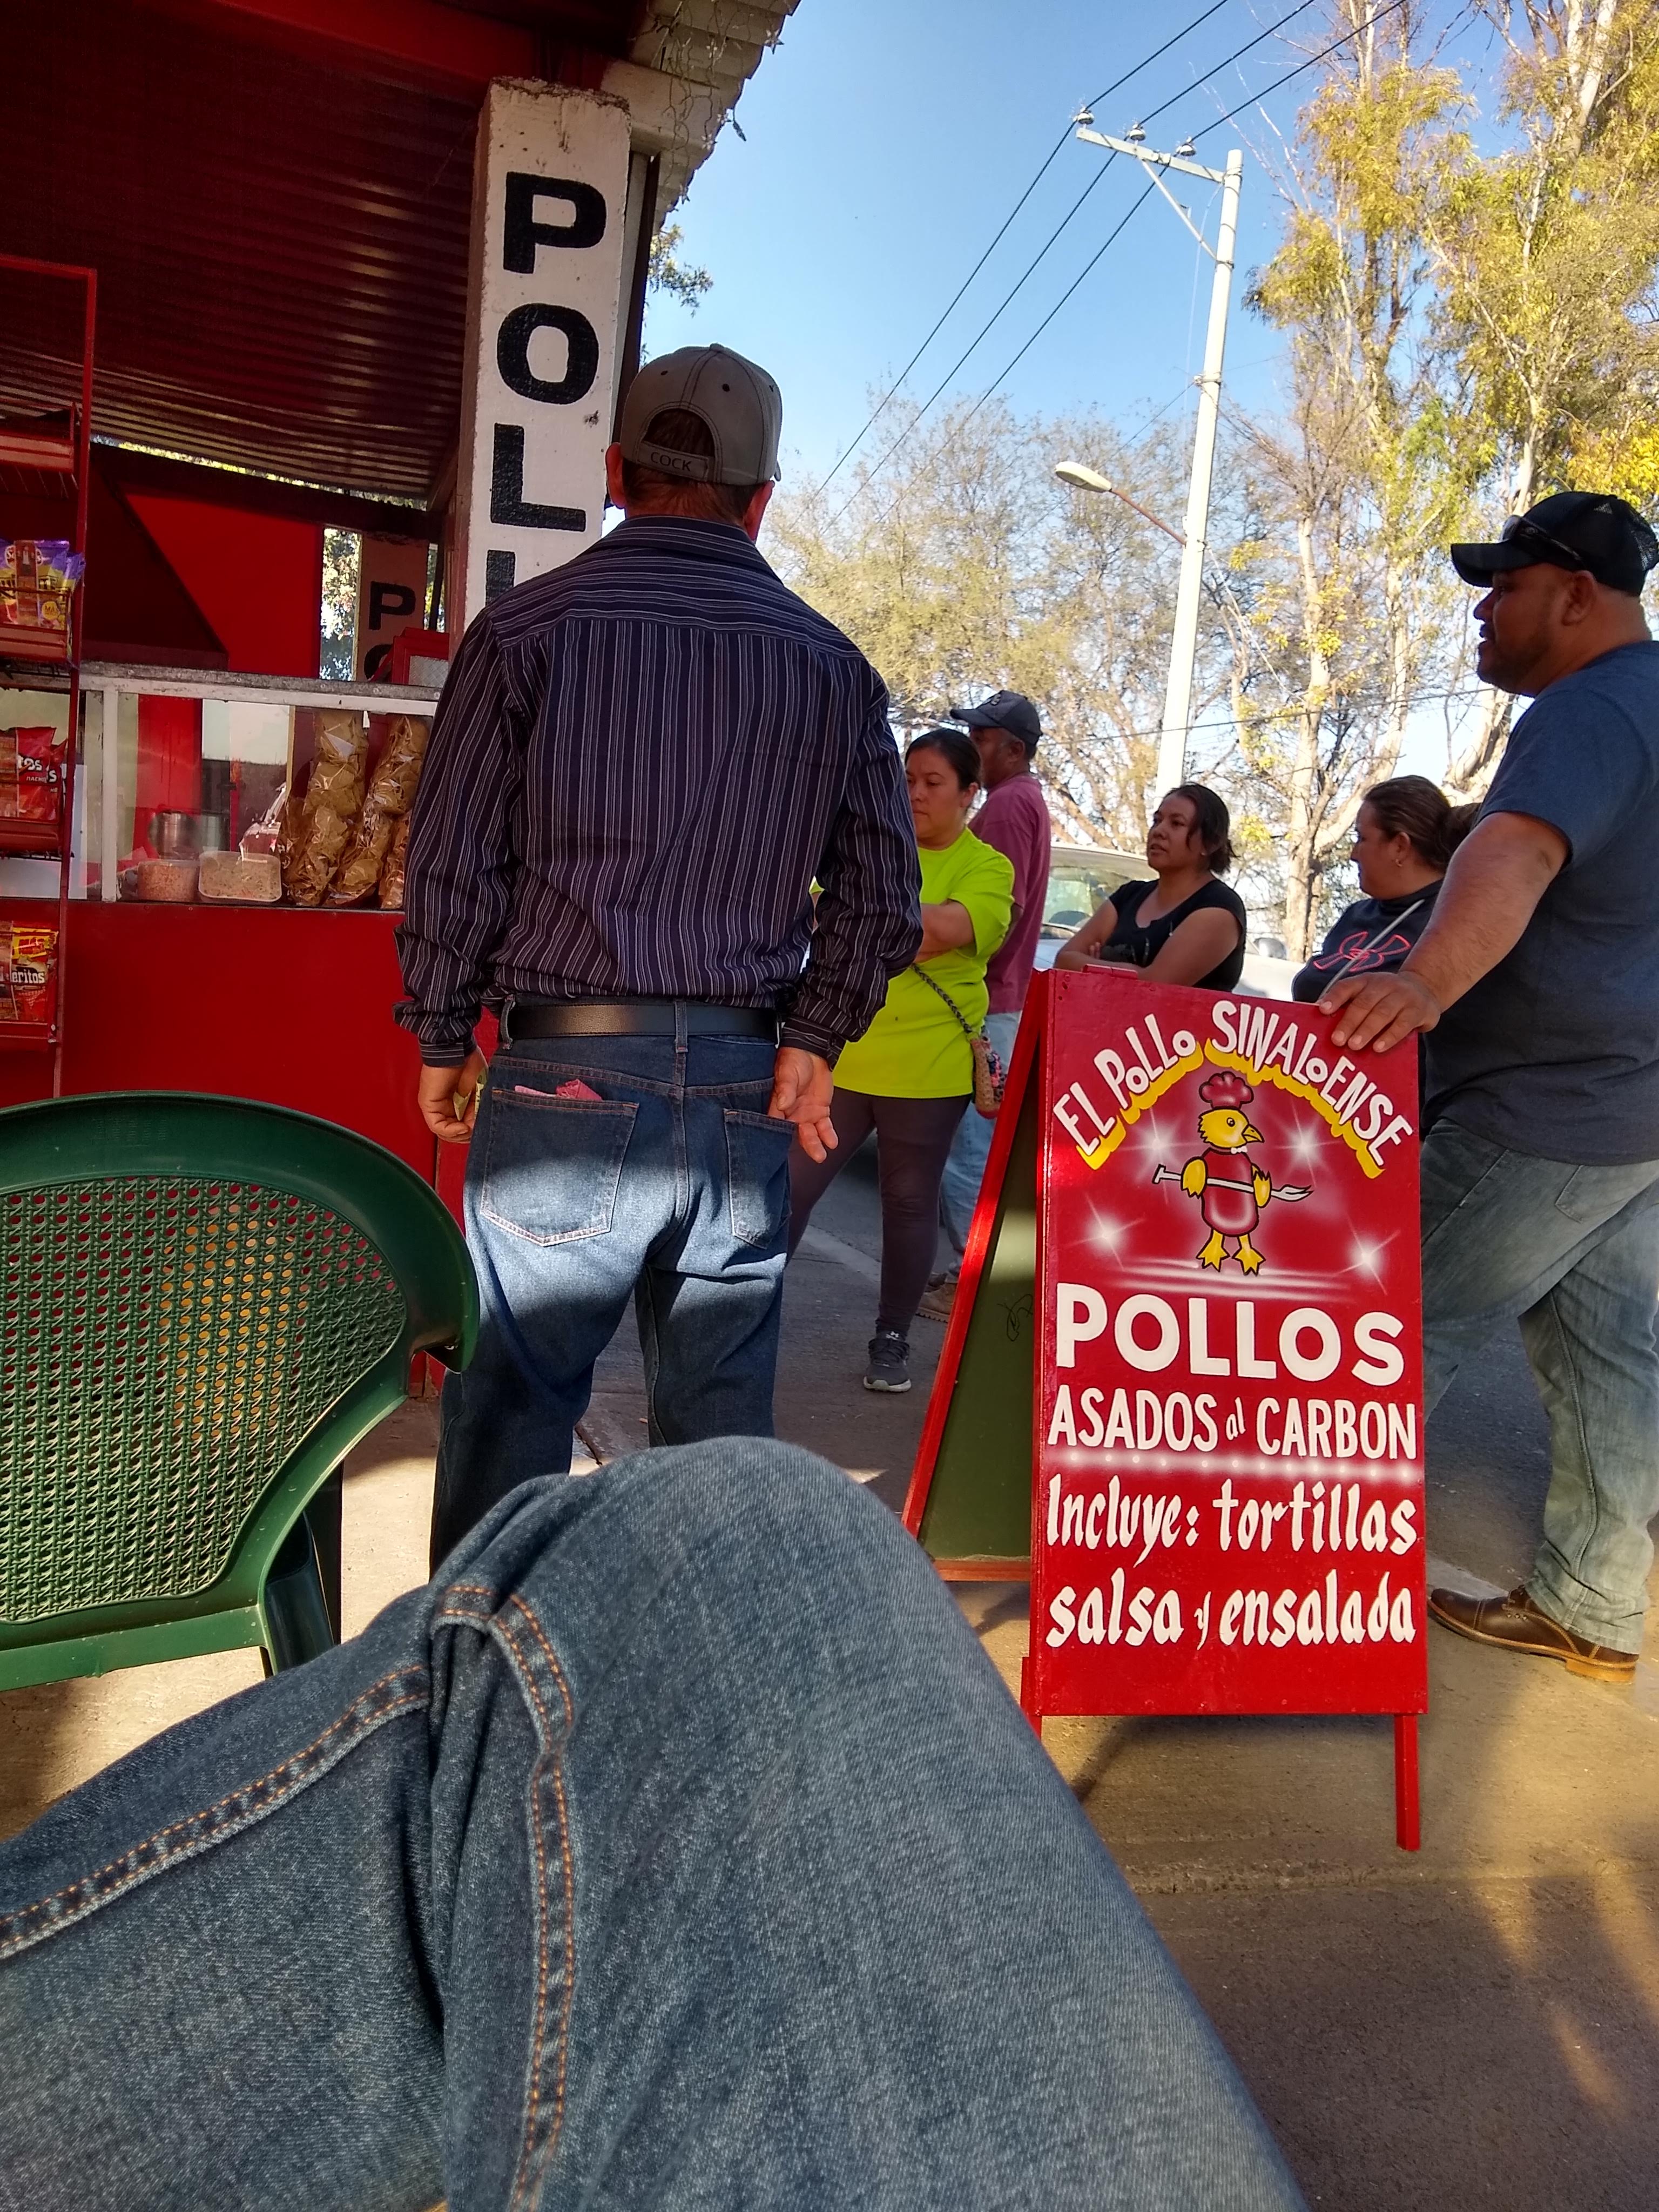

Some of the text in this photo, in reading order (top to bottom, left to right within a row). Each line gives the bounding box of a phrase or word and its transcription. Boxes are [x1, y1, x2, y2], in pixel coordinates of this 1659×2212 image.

[650, 451, 692, 472] COCK
[1053, 1082, 1116, 1156] EL
[1056, 1283, 1404, 1386] POLLOS
[1047, 1384, 1417, 1460] ASADOS al CARBON
[1047, 1473, 1417, 1567] Incluye: tortillas
[1046, 1567, 1417, 1650] salsa y ensalada
